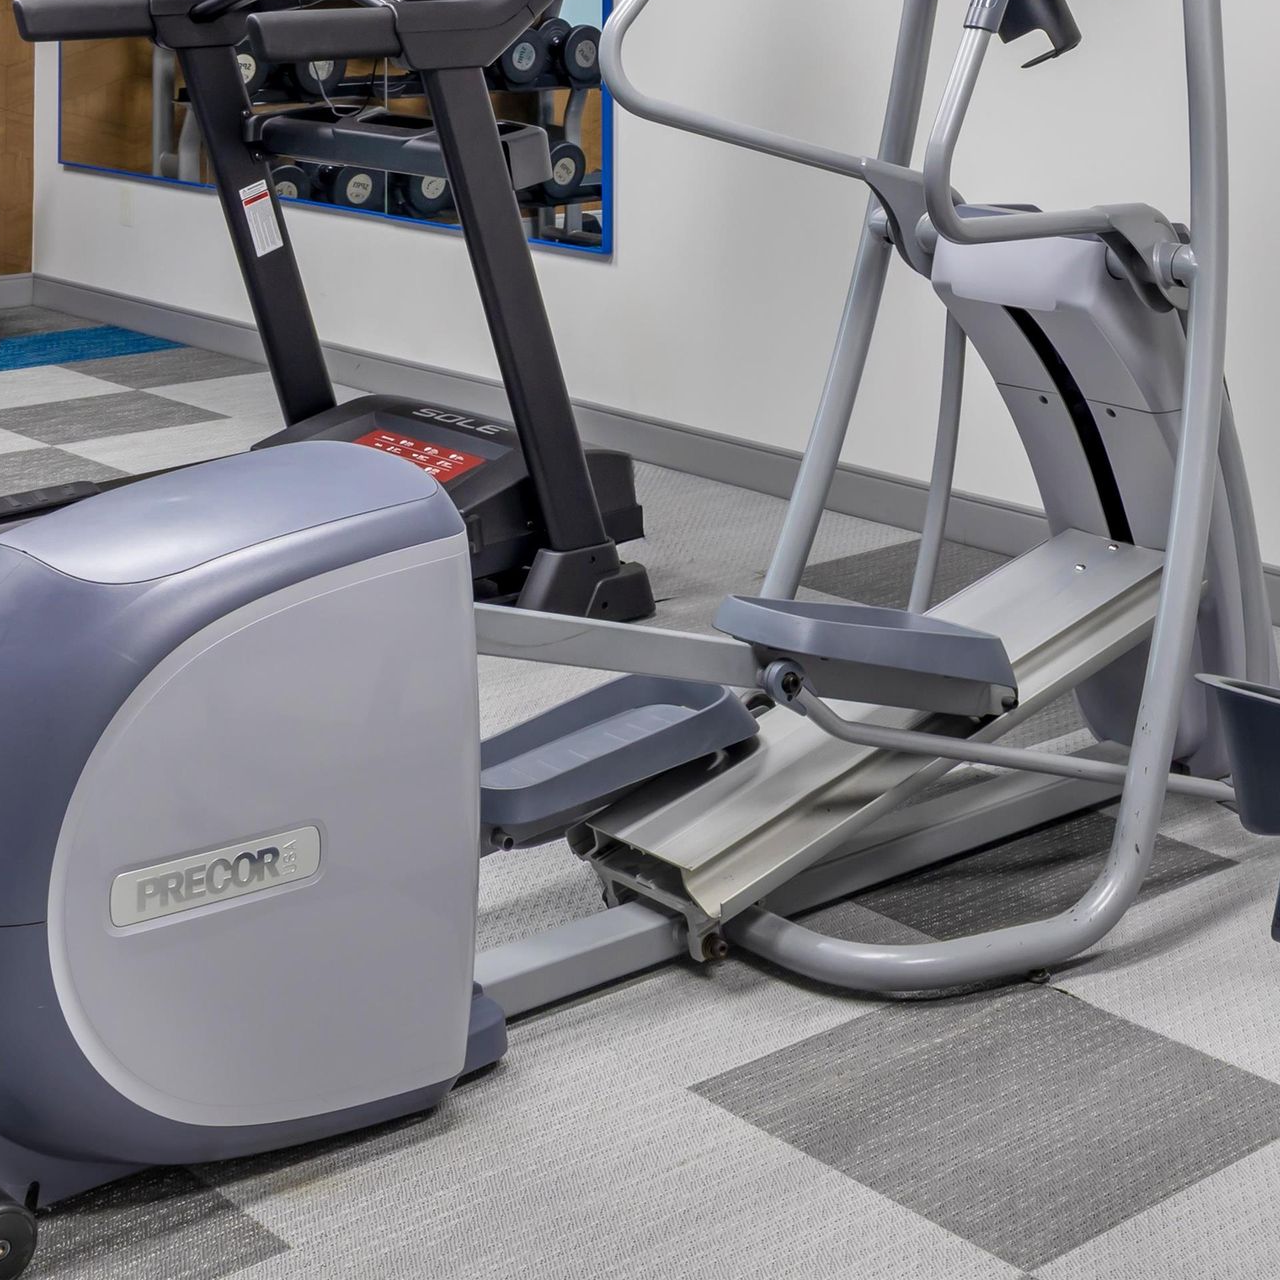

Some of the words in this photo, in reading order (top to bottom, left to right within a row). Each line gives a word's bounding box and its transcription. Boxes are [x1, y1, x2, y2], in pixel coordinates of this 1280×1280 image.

[411, 407, 510, 435] SOLE
[136, 846, 281, 913] PRECOR
[282, 839, 297, 876] USA
